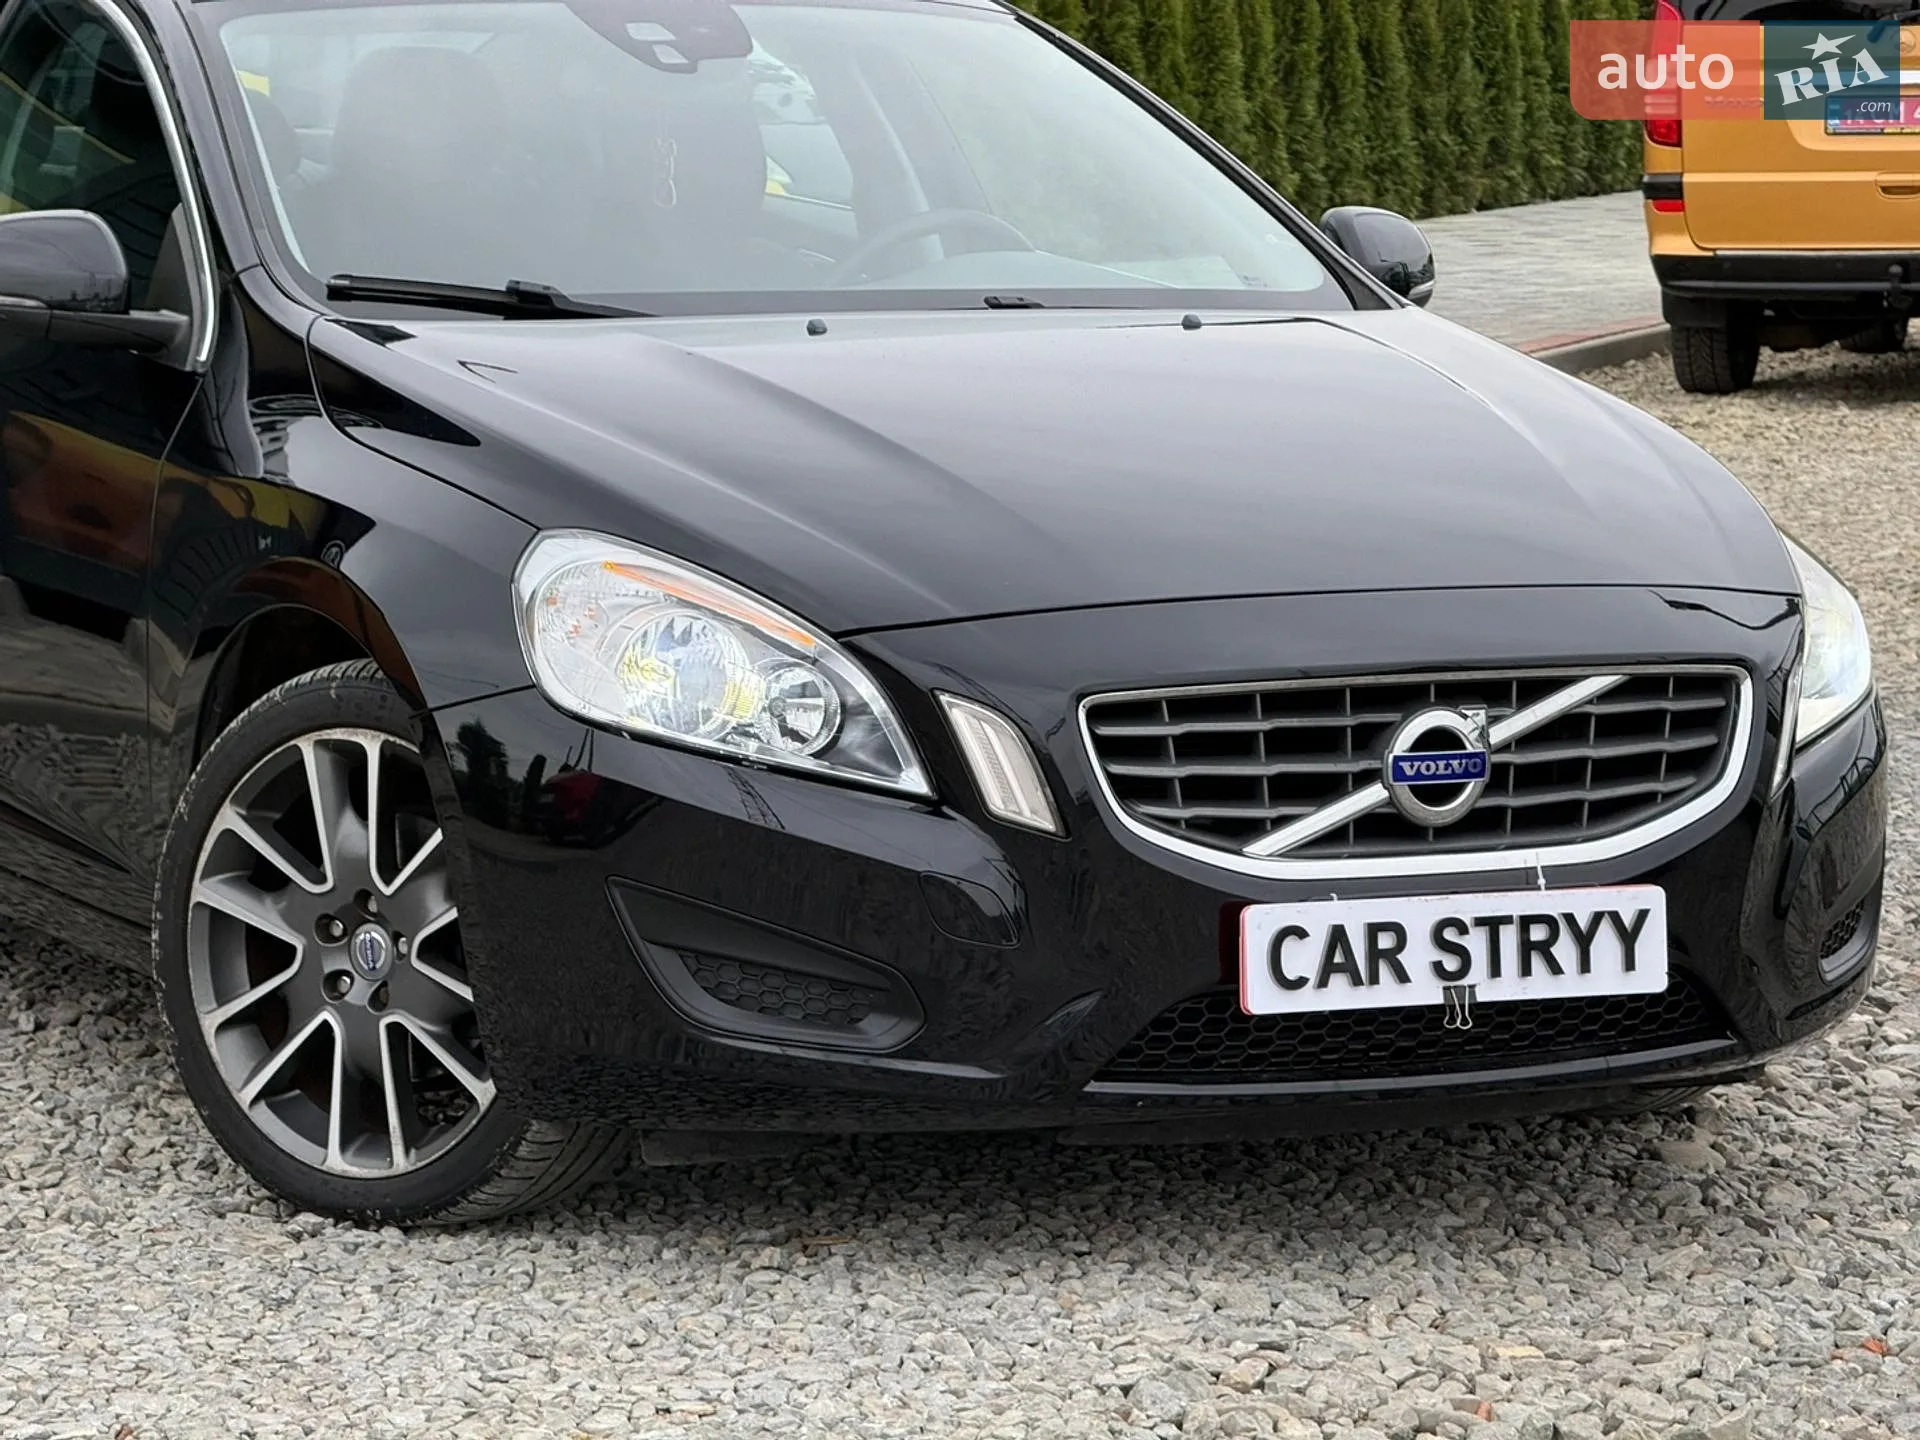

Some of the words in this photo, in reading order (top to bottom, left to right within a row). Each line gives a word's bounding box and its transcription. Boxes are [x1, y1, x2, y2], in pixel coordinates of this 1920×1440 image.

[1399, 758, 1482, 776] VOLVO
[1266, 921, 1412, 991] CAR
[1429, 908, 1651, 983] STRYY
